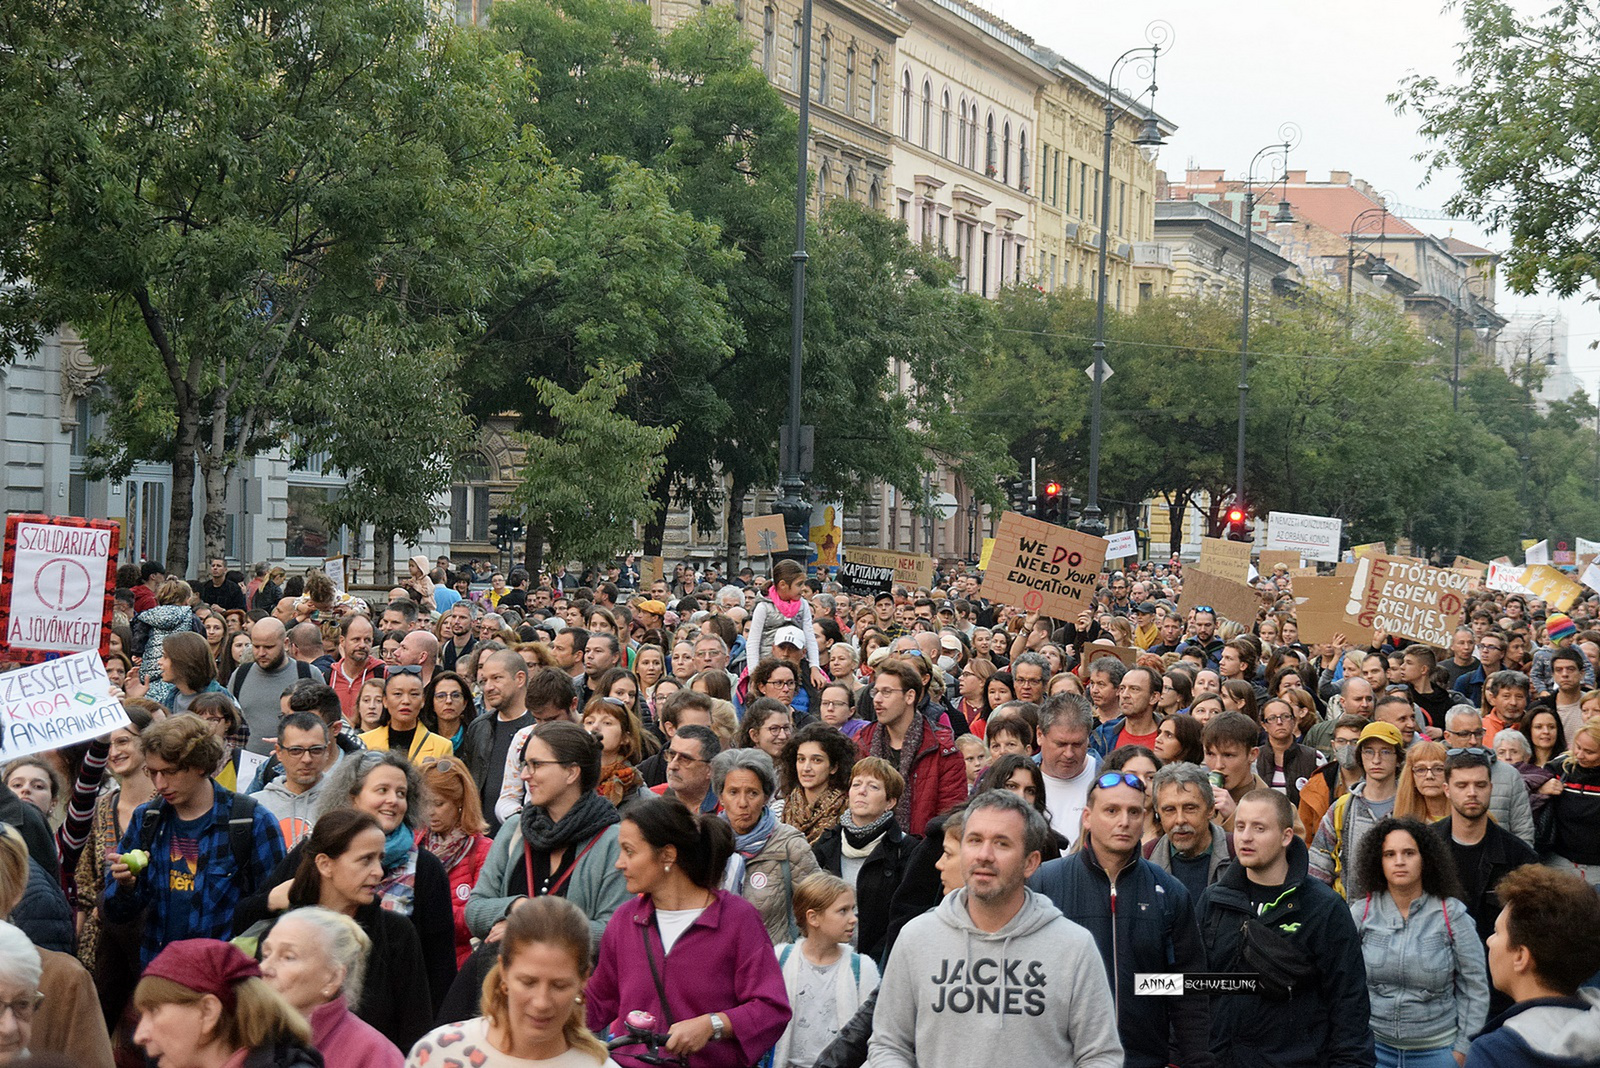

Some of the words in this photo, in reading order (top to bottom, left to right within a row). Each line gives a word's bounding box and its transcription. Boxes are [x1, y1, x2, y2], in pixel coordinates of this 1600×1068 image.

[19, 526, 109, 557] SZOLIDARITÁS
[1019, 536, 1048, 557] WE
[1052, 546, 1082, 567] DO
[899, 558, 915, 571] NEM
[1015, 554, 1060, 576] NEED
[1064, 568, 1096, 585] YOUR
[9, 616, 23, 641] A
[25, 615, 100, 645] JÖVŐNKÉRT
[931, 985, 1046, 1017] JONES
